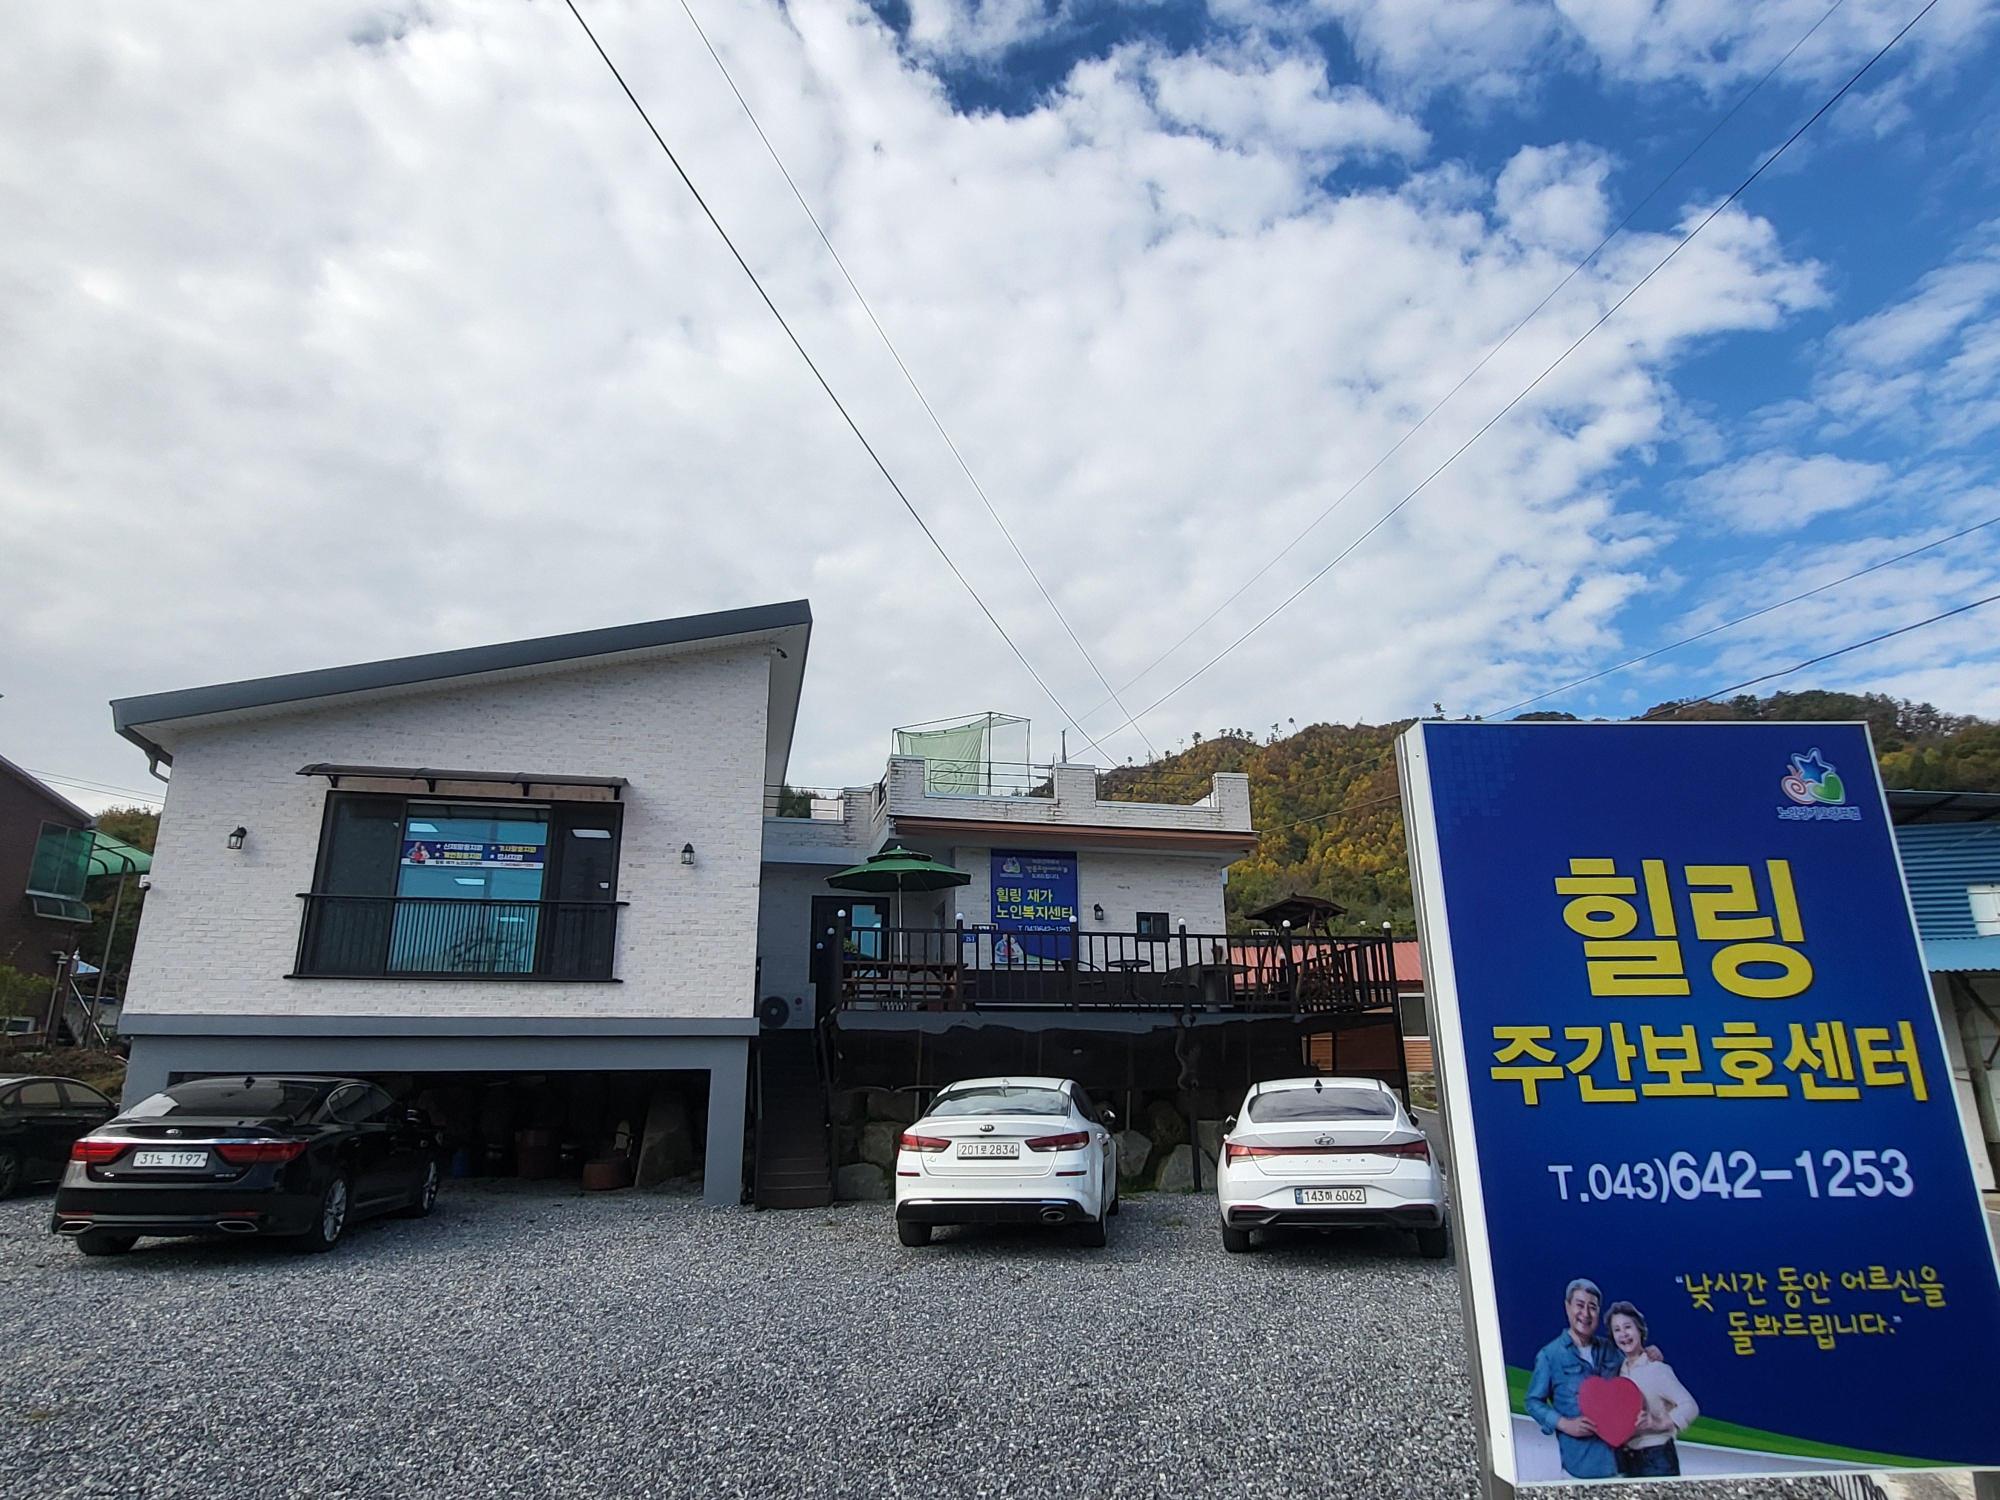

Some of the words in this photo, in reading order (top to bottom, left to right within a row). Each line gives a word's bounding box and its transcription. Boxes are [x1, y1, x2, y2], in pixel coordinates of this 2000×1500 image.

[996, 887, 1021, 903] 힐링
[1027, 888, 1053, 903] 재가
[995, 904, 1073, 920] 노인복지센터
[1554, 858, 1814, 999] 힐링
[1491, 1021, 1928, 1105] 주간보호센터
[961, 1144, 988, 1156] 201로
[989, 1144, 1015, 1156] 2834
[140, 1153, 163, 1165] 31노
[171, 1153, 202, 1165] 1197
[1548, 1149, 1915, 1204] T.043)642-1253
[1335, 1189, 1363, 1202] 6062
[1777, 1266, 1832, 1309] 동안
[1840, 1265, 1947, 1309] 어르신을
